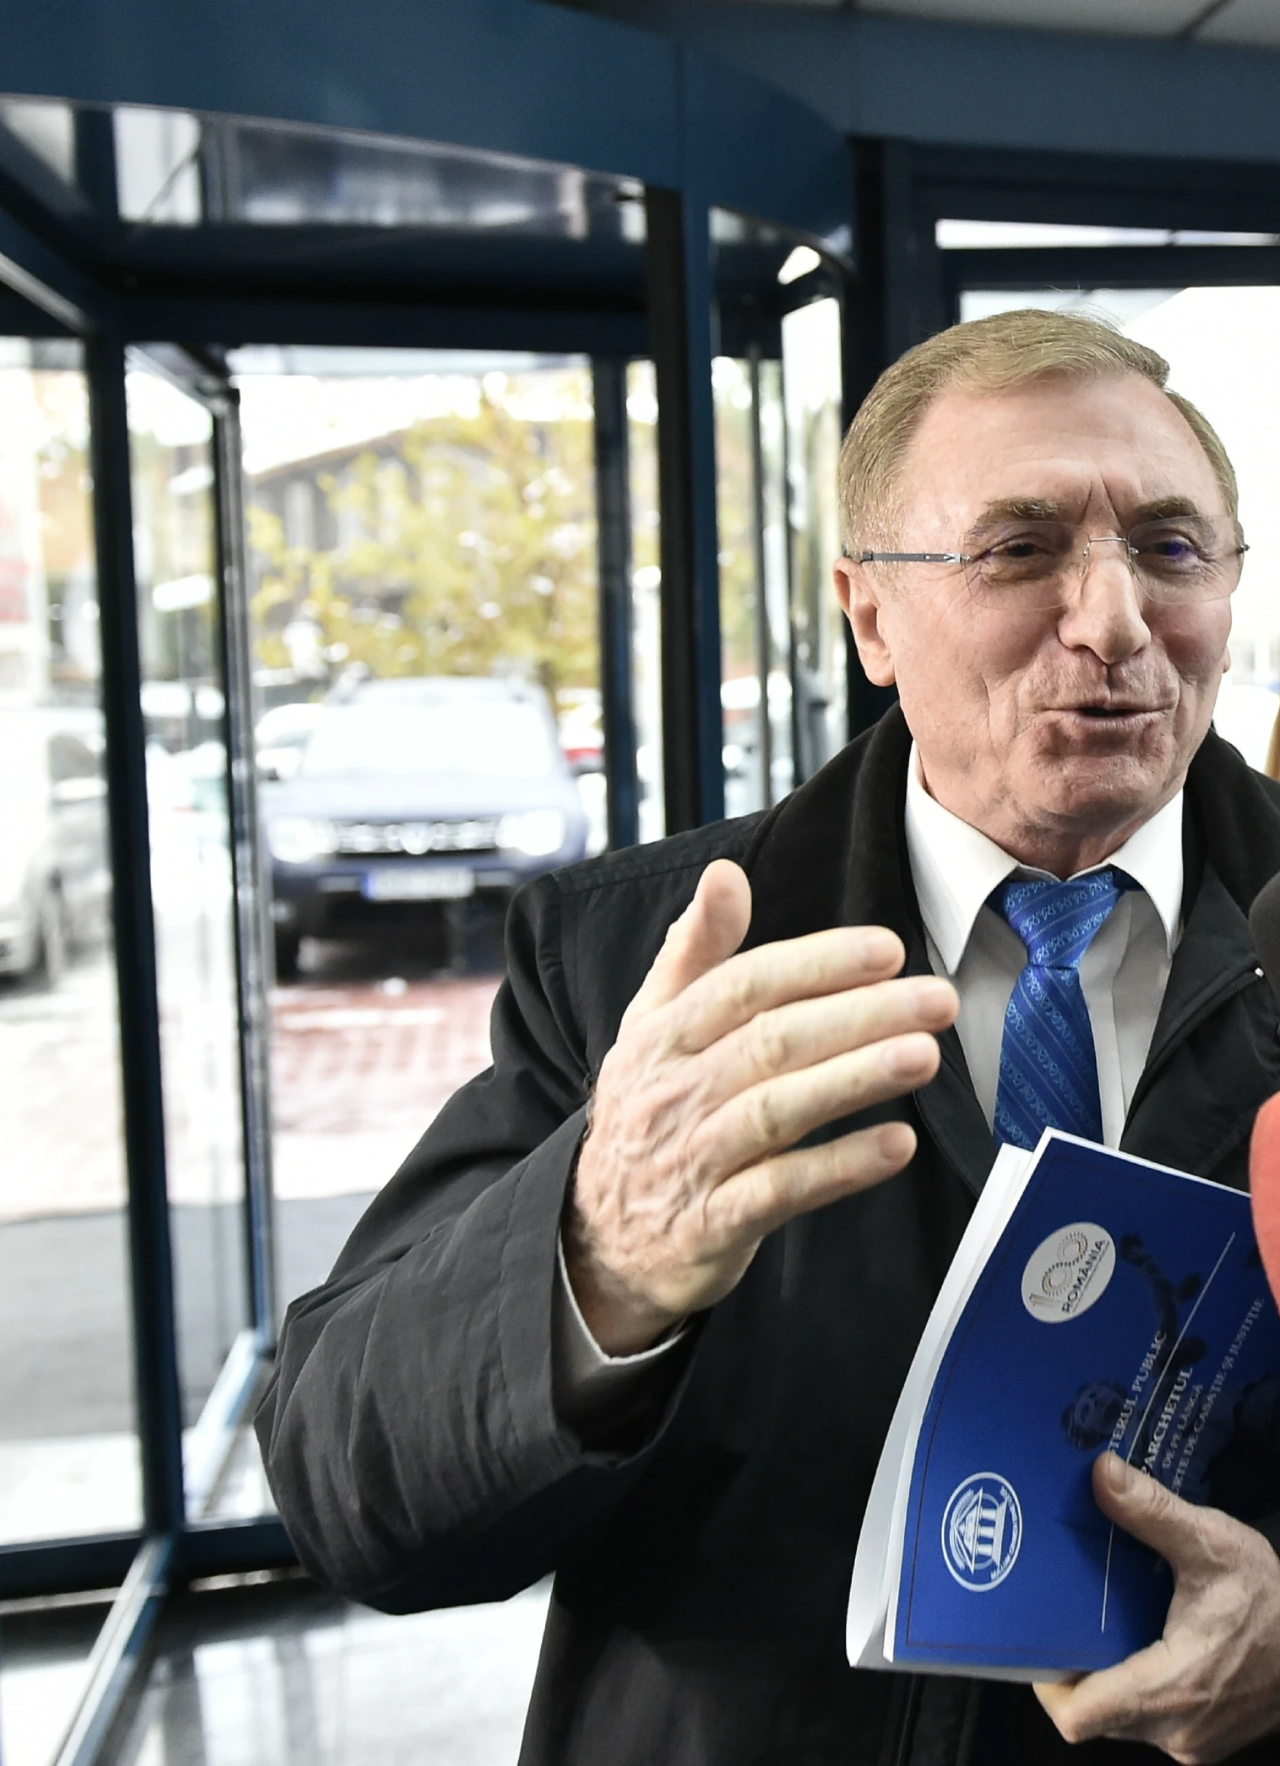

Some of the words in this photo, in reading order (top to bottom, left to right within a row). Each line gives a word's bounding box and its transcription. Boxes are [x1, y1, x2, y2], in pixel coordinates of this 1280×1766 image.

[1131, 1329, 1166, 1392] PUBLIC
[1184, 1434, 1198, 1456] DE
[1162, 1449, 1176, 1469] DE
